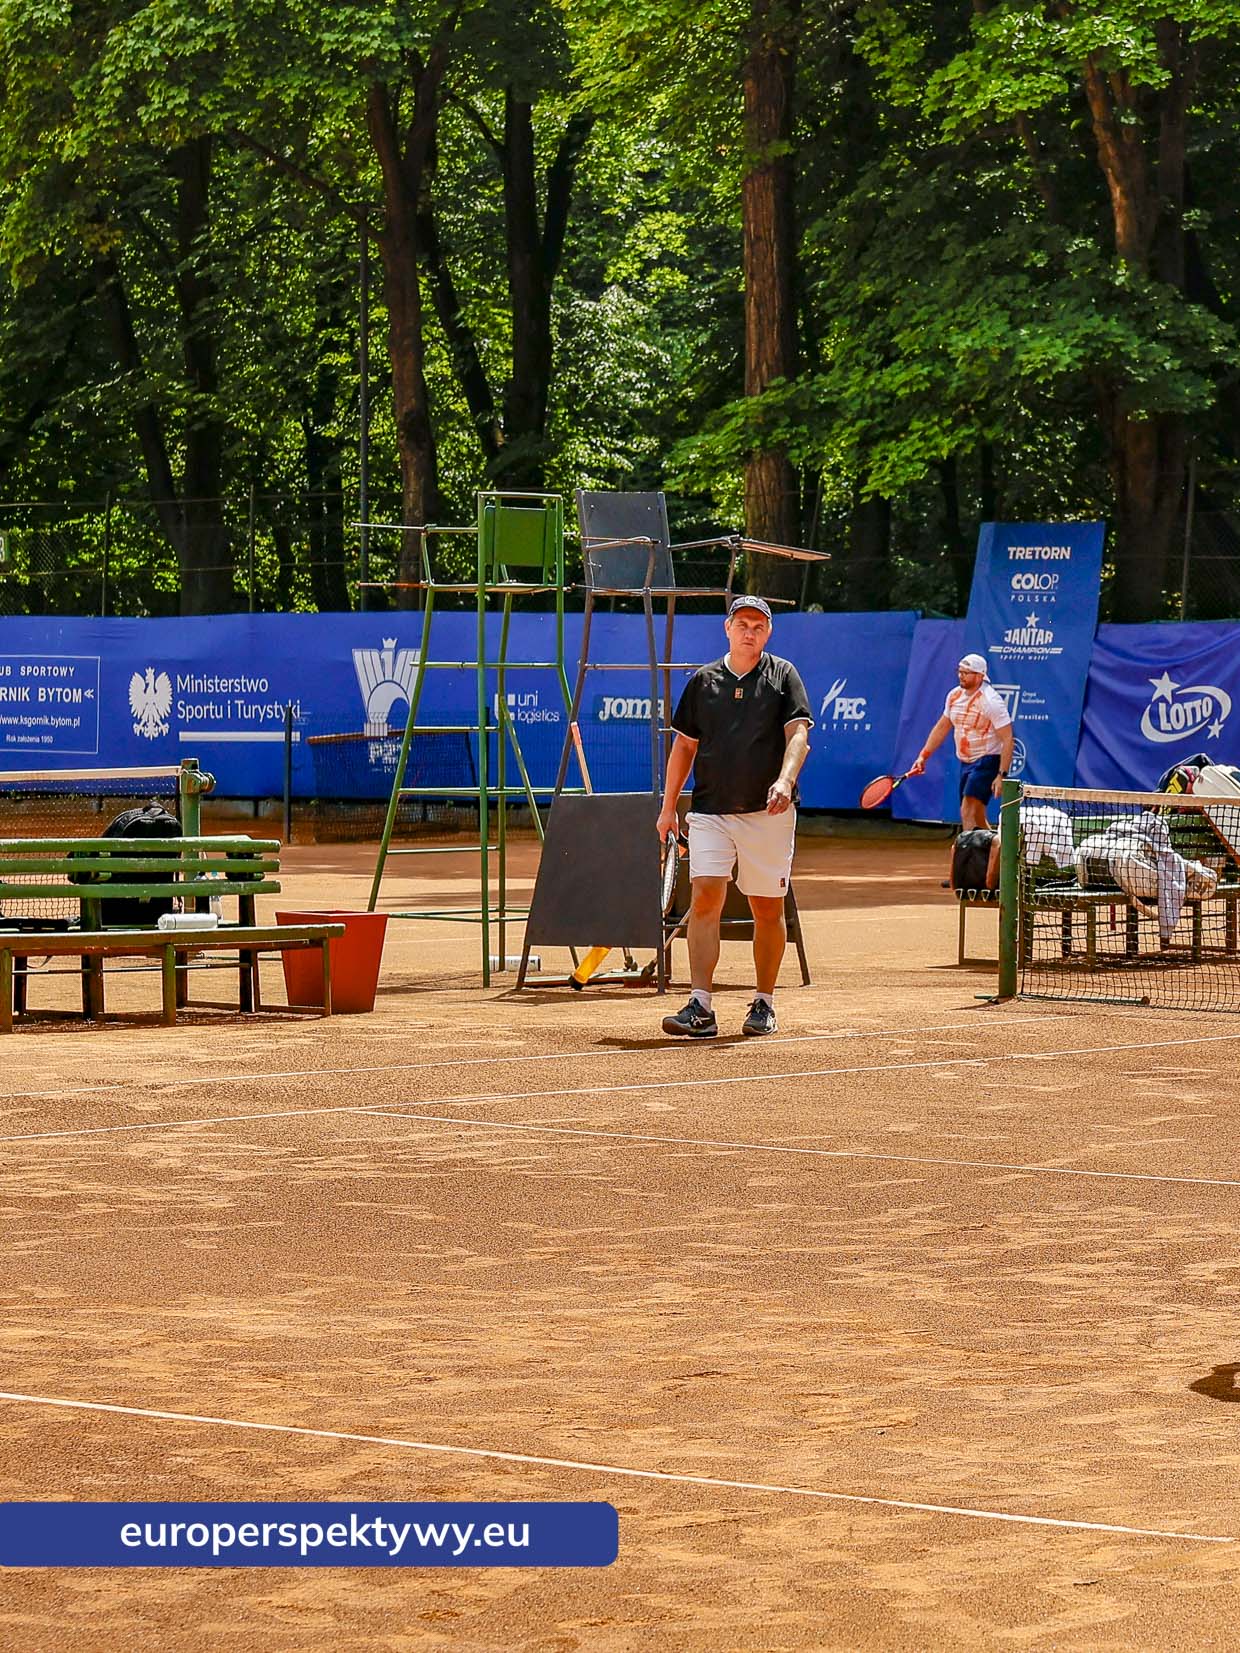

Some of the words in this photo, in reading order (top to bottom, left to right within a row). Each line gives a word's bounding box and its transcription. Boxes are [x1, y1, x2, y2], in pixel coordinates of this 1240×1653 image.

[1008, 546, 1071, 560] TRETORN
[1011, 573, 1059, 590] COLOP
[1010, 594, 1056, 603] POLSKA
[1004, 628, 1053, 646] JANTAR
[20, 665, 75, 677] SPORTOWY
[176, 673, 269, 693] Ministerstwo
[517, 690, 539, 707] uni
[177, 700, 224, 723] Sportu
[226, 699, 232, 719] i
[234, 699, 301, 723] Turystyki
[517, 708, 560, 723] logistics
[832, 697, 867, 720] PEC
[1158, 696, 1213, 731] LOTTO
